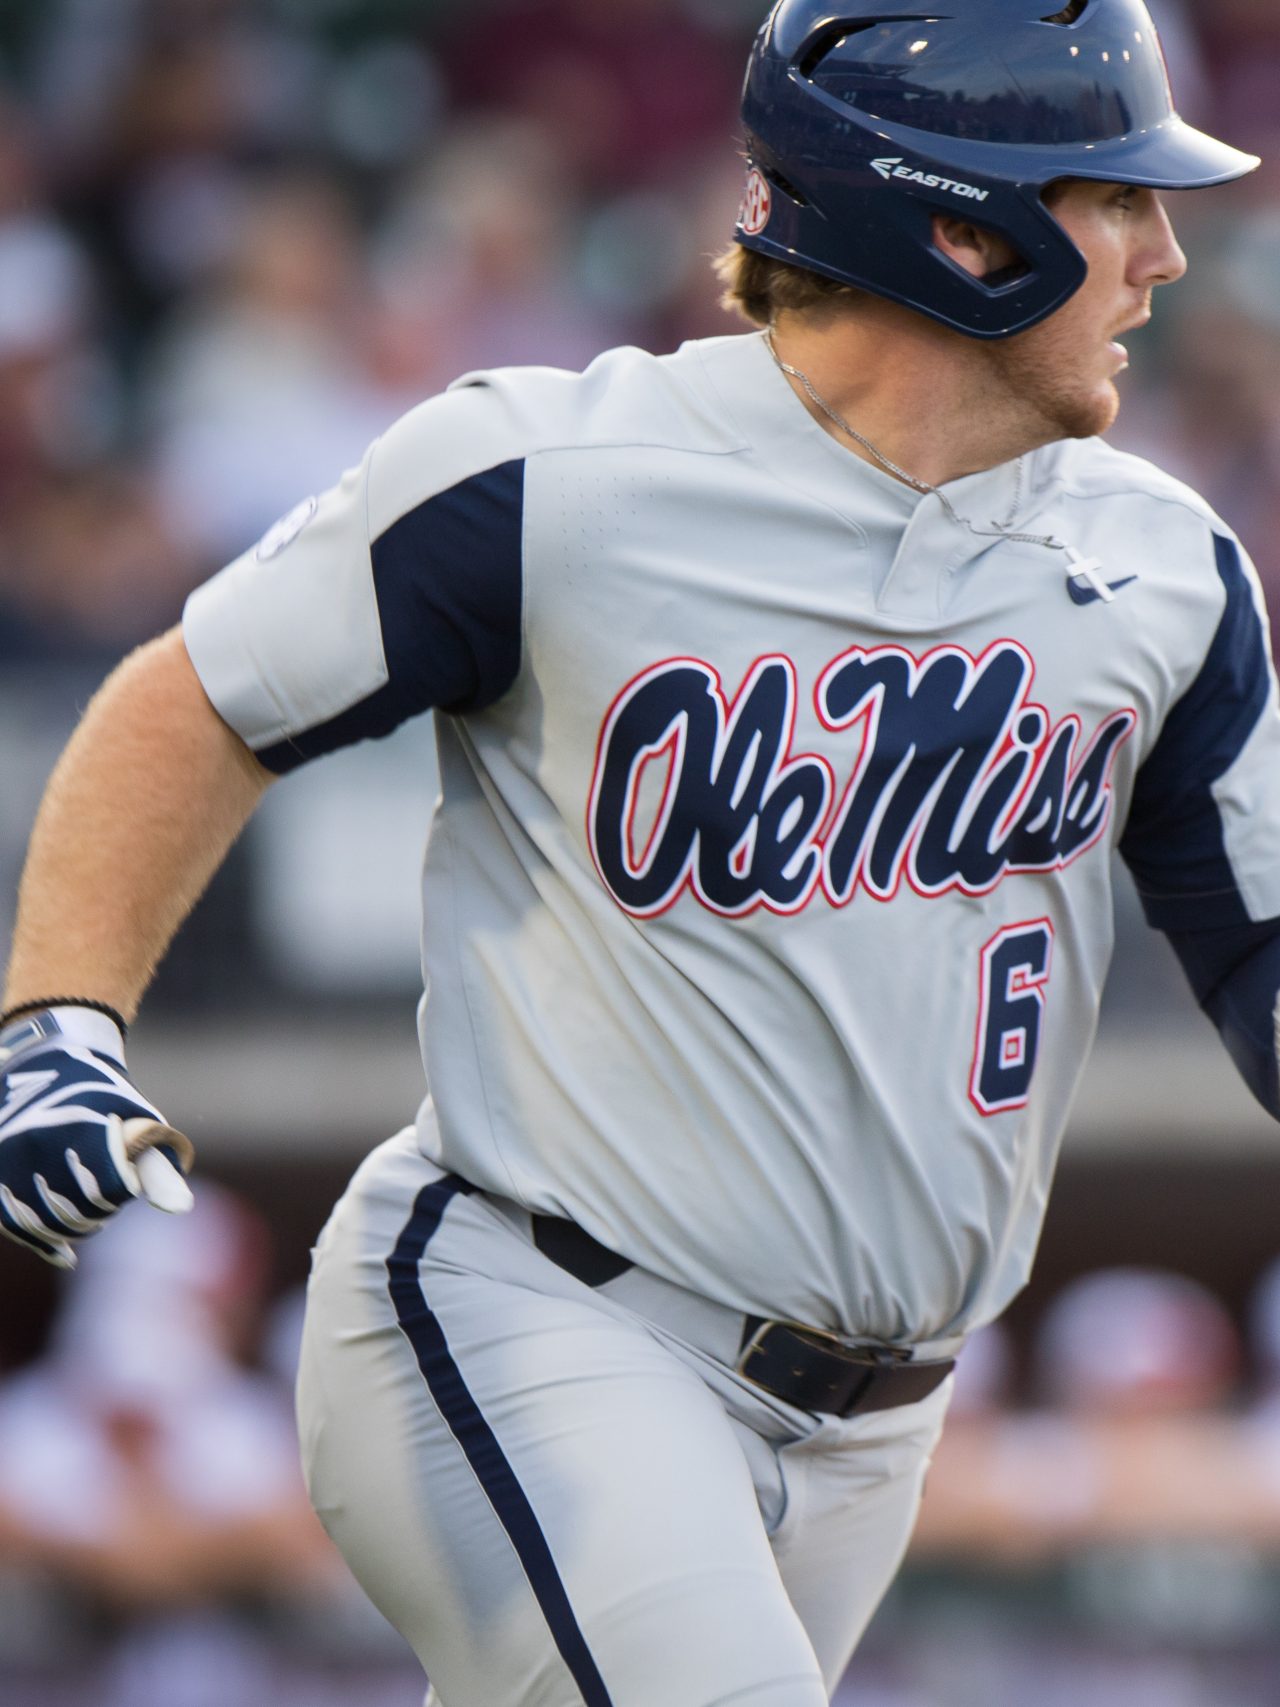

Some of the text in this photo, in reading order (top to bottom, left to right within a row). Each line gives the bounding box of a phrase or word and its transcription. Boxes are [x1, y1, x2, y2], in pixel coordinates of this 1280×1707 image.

[891, 165, 989, 201] EASTON
[586, 638, 1137, 919] Ole Miss
[968, 916, 1054, 1117] 6
